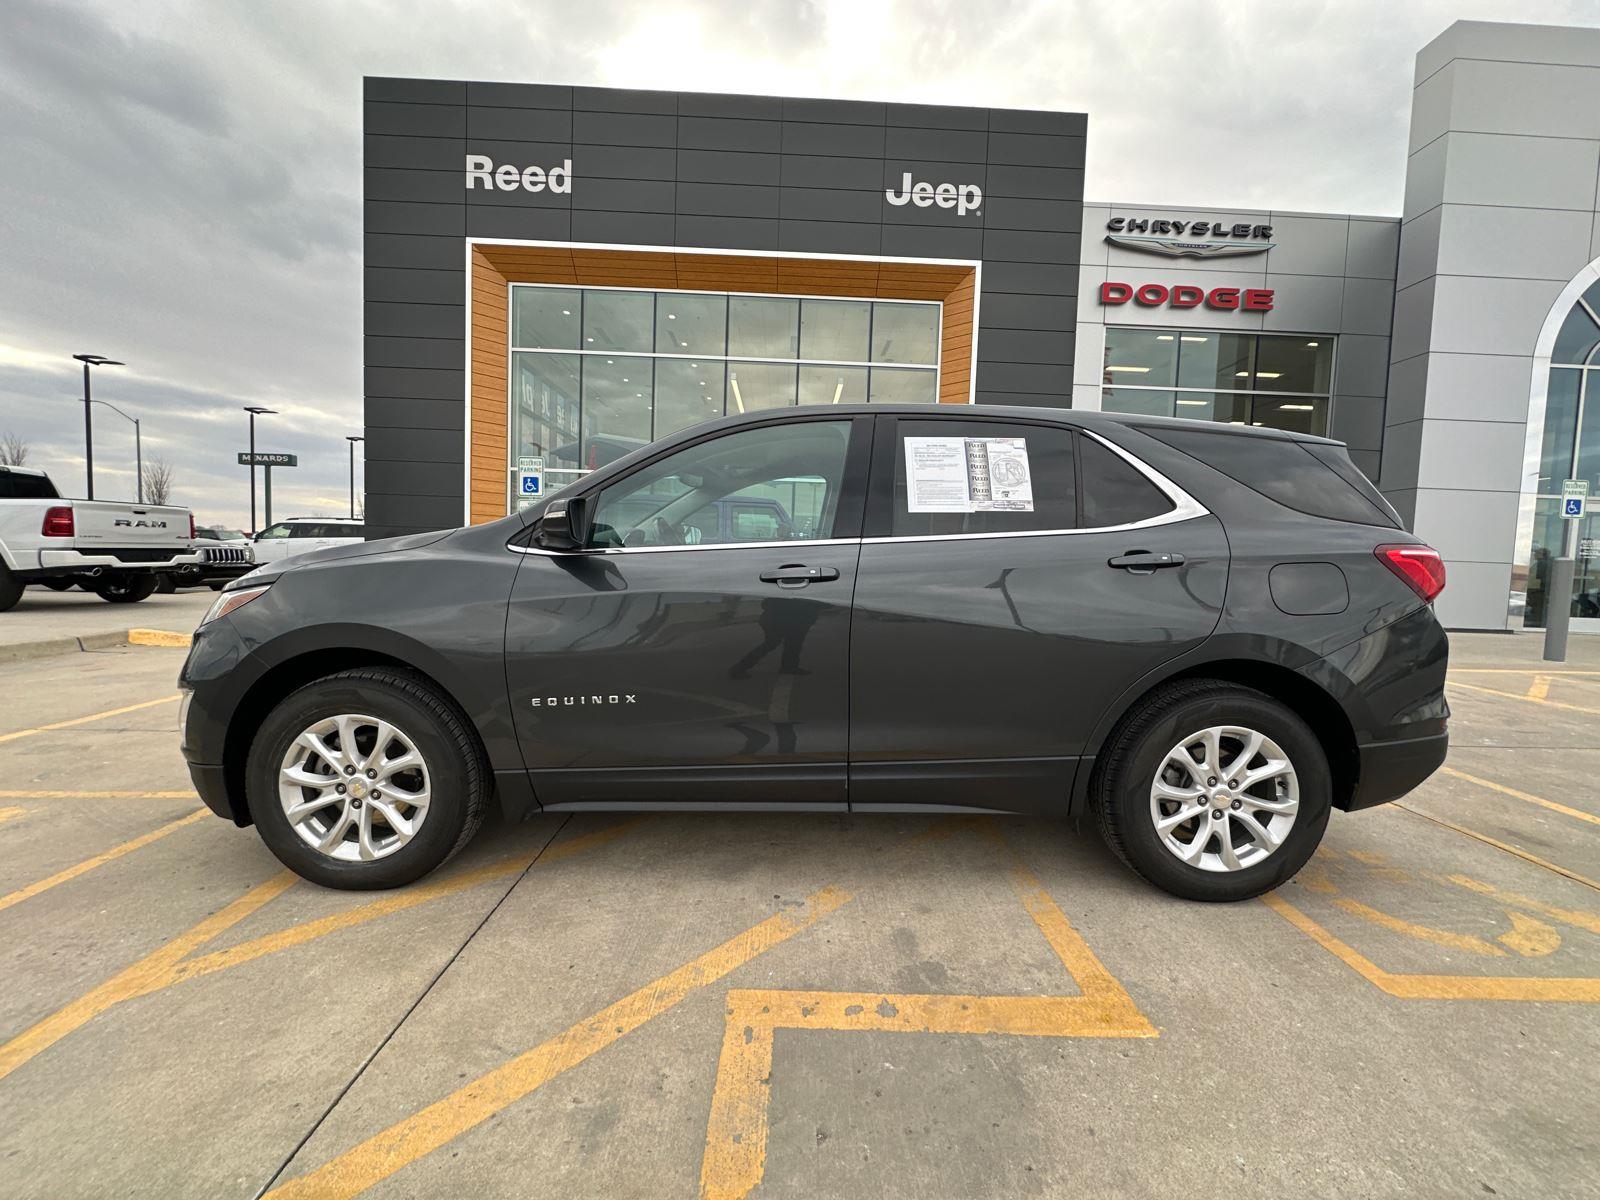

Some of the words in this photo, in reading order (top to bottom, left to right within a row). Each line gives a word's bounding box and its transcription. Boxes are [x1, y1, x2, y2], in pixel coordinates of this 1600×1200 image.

[466, 154, 572, 194] Reed
[886, 172, 982, 216] Jeep
[1107, 217, 1273, 238] CHRYSLER
[1099, 282, 1275, 312] DODGE
[114, 519, 168, 528] RAM
[531, 694, 636, 706] EQUINOX
